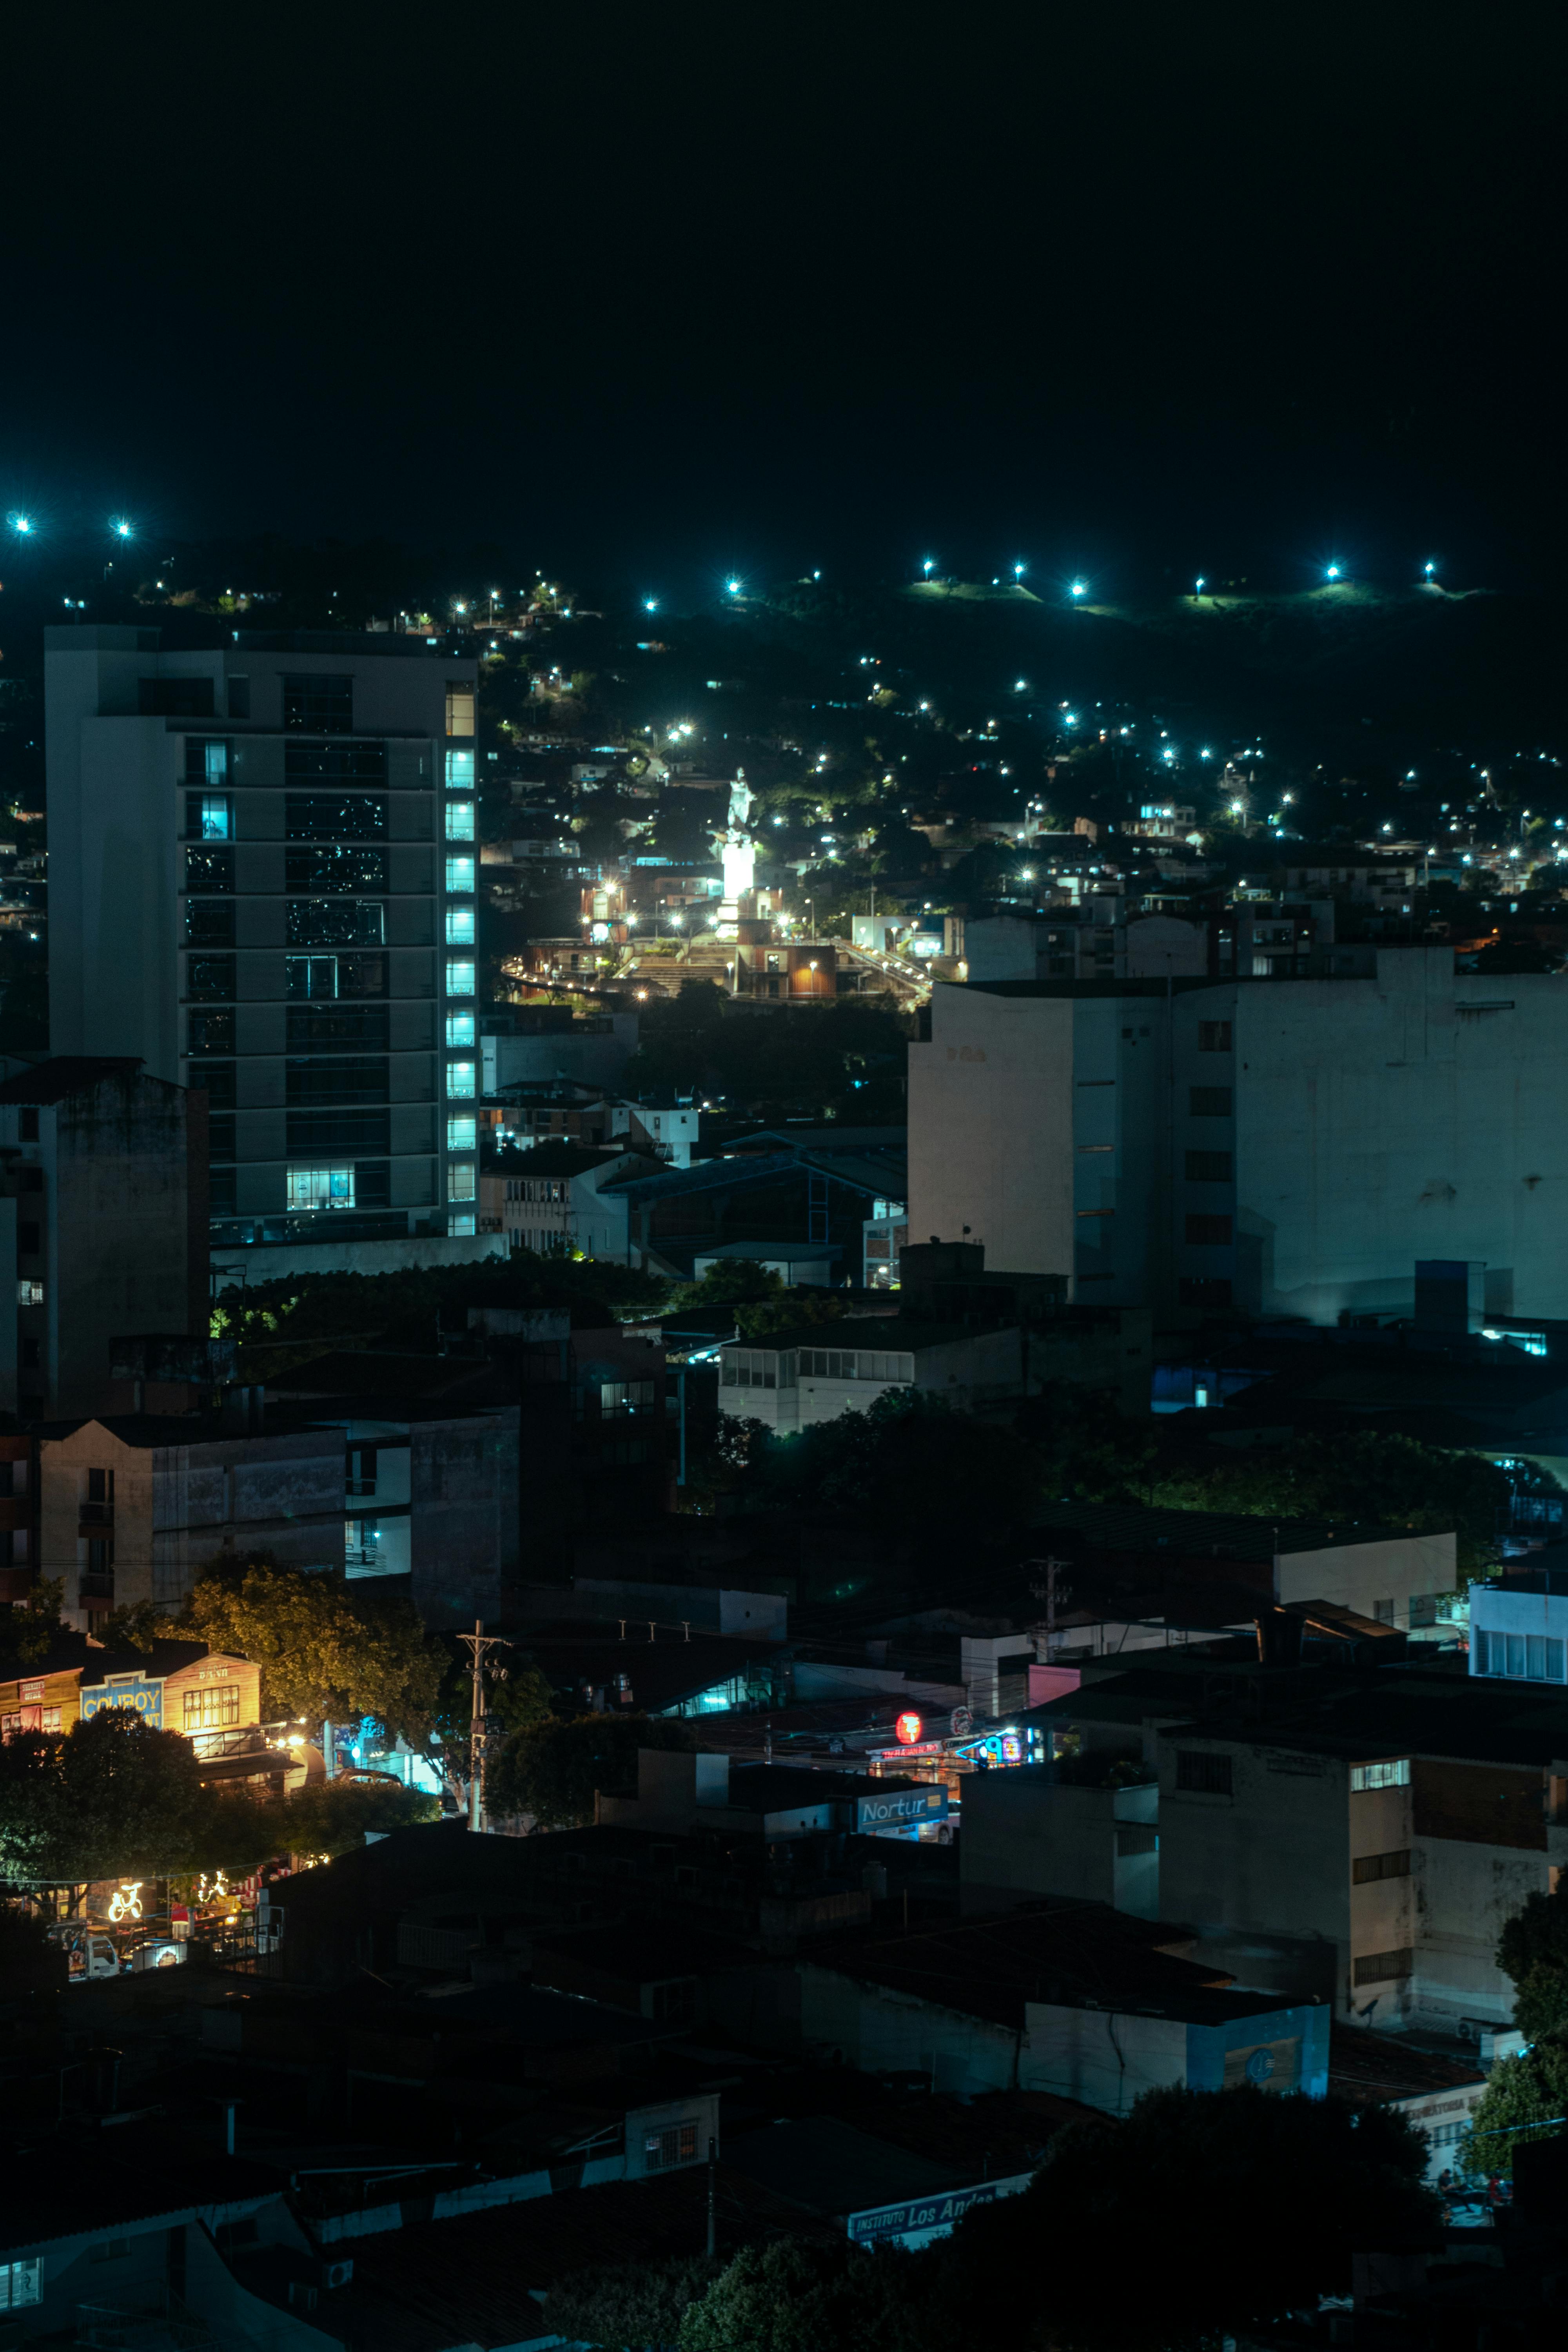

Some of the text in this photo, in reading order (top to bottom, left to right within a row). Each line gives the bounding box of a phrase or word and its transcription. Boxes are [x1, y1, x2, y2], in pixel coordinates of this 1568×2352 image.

[199, 1664, 228, 1679] BANK
[863, 1798, 926, 1822] Nortur
[857, 2210, 905, 2232] INSTITUTO
[908, 2207, 936, 2227] Los
